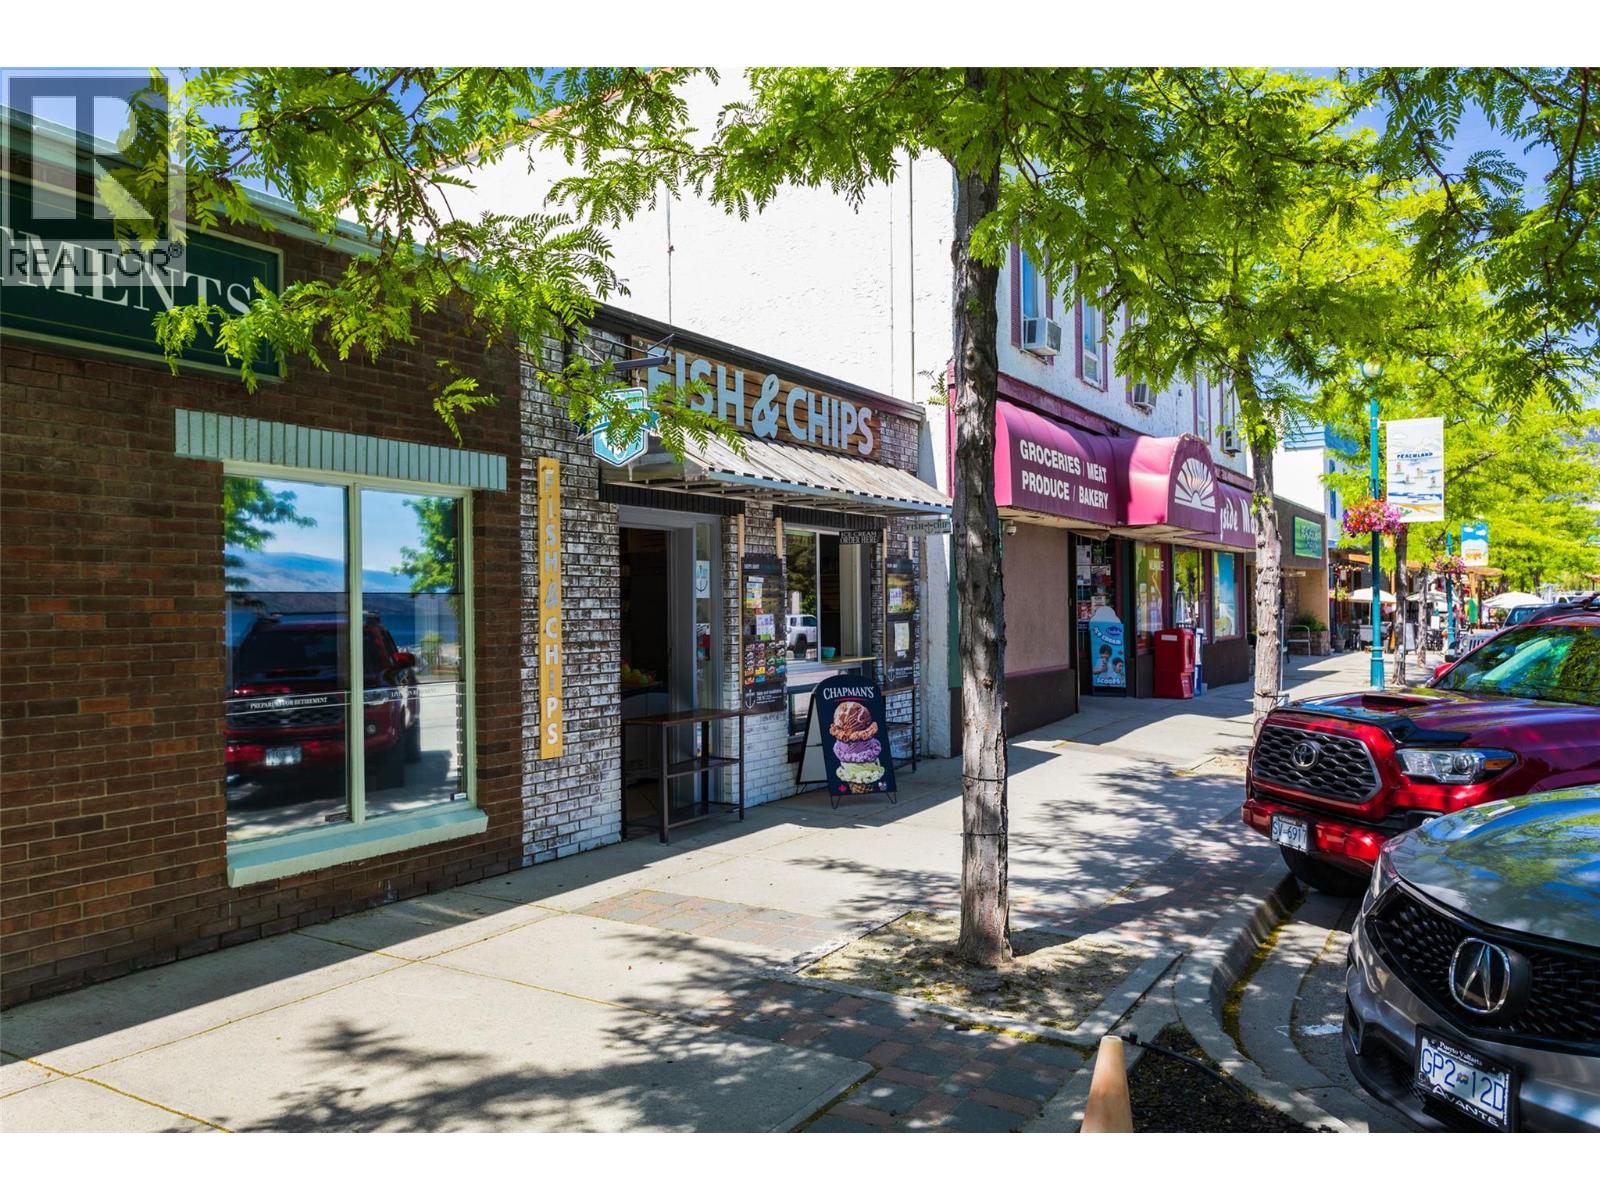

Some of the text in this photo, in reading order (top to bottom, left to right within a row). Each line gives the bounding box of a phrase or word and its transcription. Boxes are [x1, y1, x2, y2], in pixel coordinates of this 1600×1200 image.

[648, 345, 744, 427] FISH
[786, 387, 873, 455] CHIPS
[1020, 440, 1107, 484] GROCERIES MEAT
[1396, 451, 1433, 459] PEACHLAND
[1021, 470, 1108, 509] PRODUCE BAKERY
[544, 469, 558, 574] FISH
[861, 536, 878, 544] HERE
[545, 617, 558, 745] CHIPS
[823, 686, 874, 700] CHAPMAN'S
[1432, 1083, 1499, 1127] AVANTE
